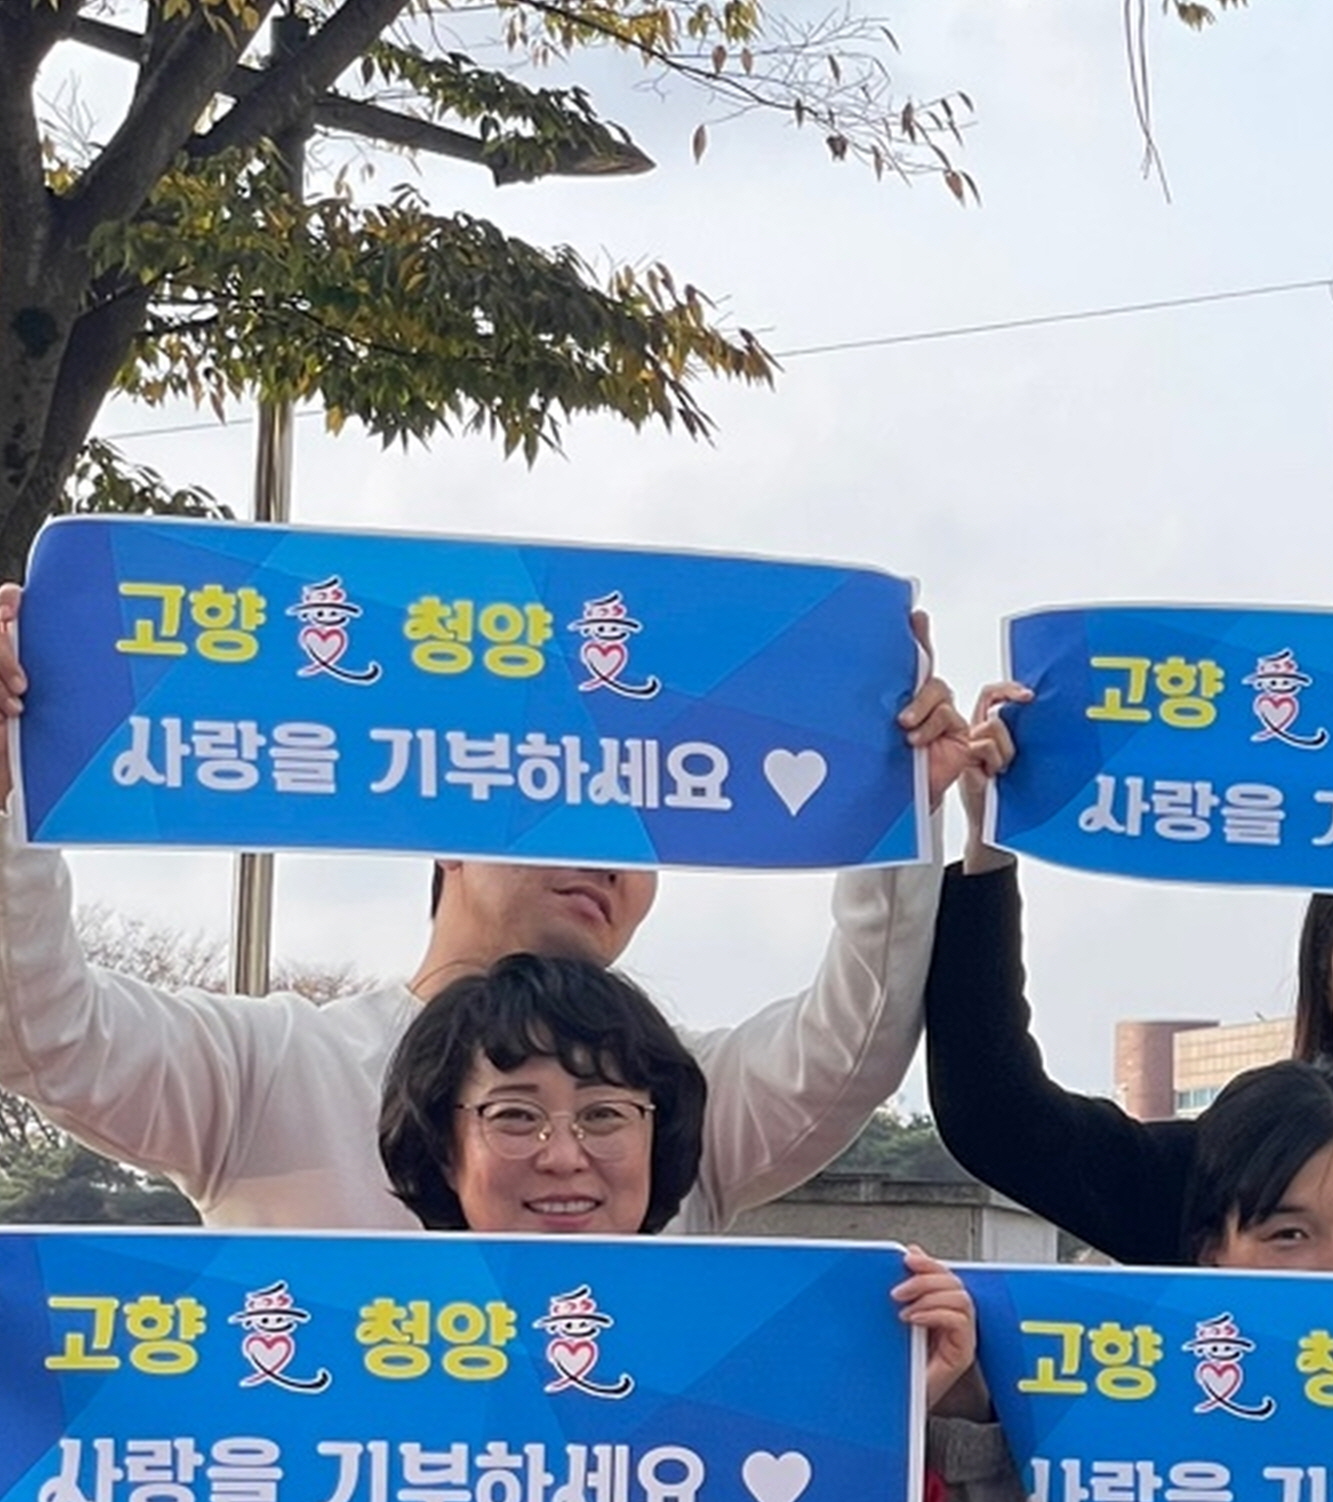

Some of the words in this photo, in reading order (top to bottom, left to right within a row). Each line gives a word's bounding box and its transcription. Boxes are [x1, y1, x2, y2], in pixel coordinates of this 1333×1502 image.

[117, 584, 267, 663] 고향
[405, 598, 553, 678] 청양
[1087, 658, 1224, 728] 고향
[114, 717, 340, 794] 사랑을
[371, 730, 733, 811] 기부하세요
[1080, 776, 1286, 845] 사랑을
[46, 1297, 207, 1375] 고향
[357, 1299, 517, 1381] 청양
[1019, 1322, 1163, 1400] 고향
